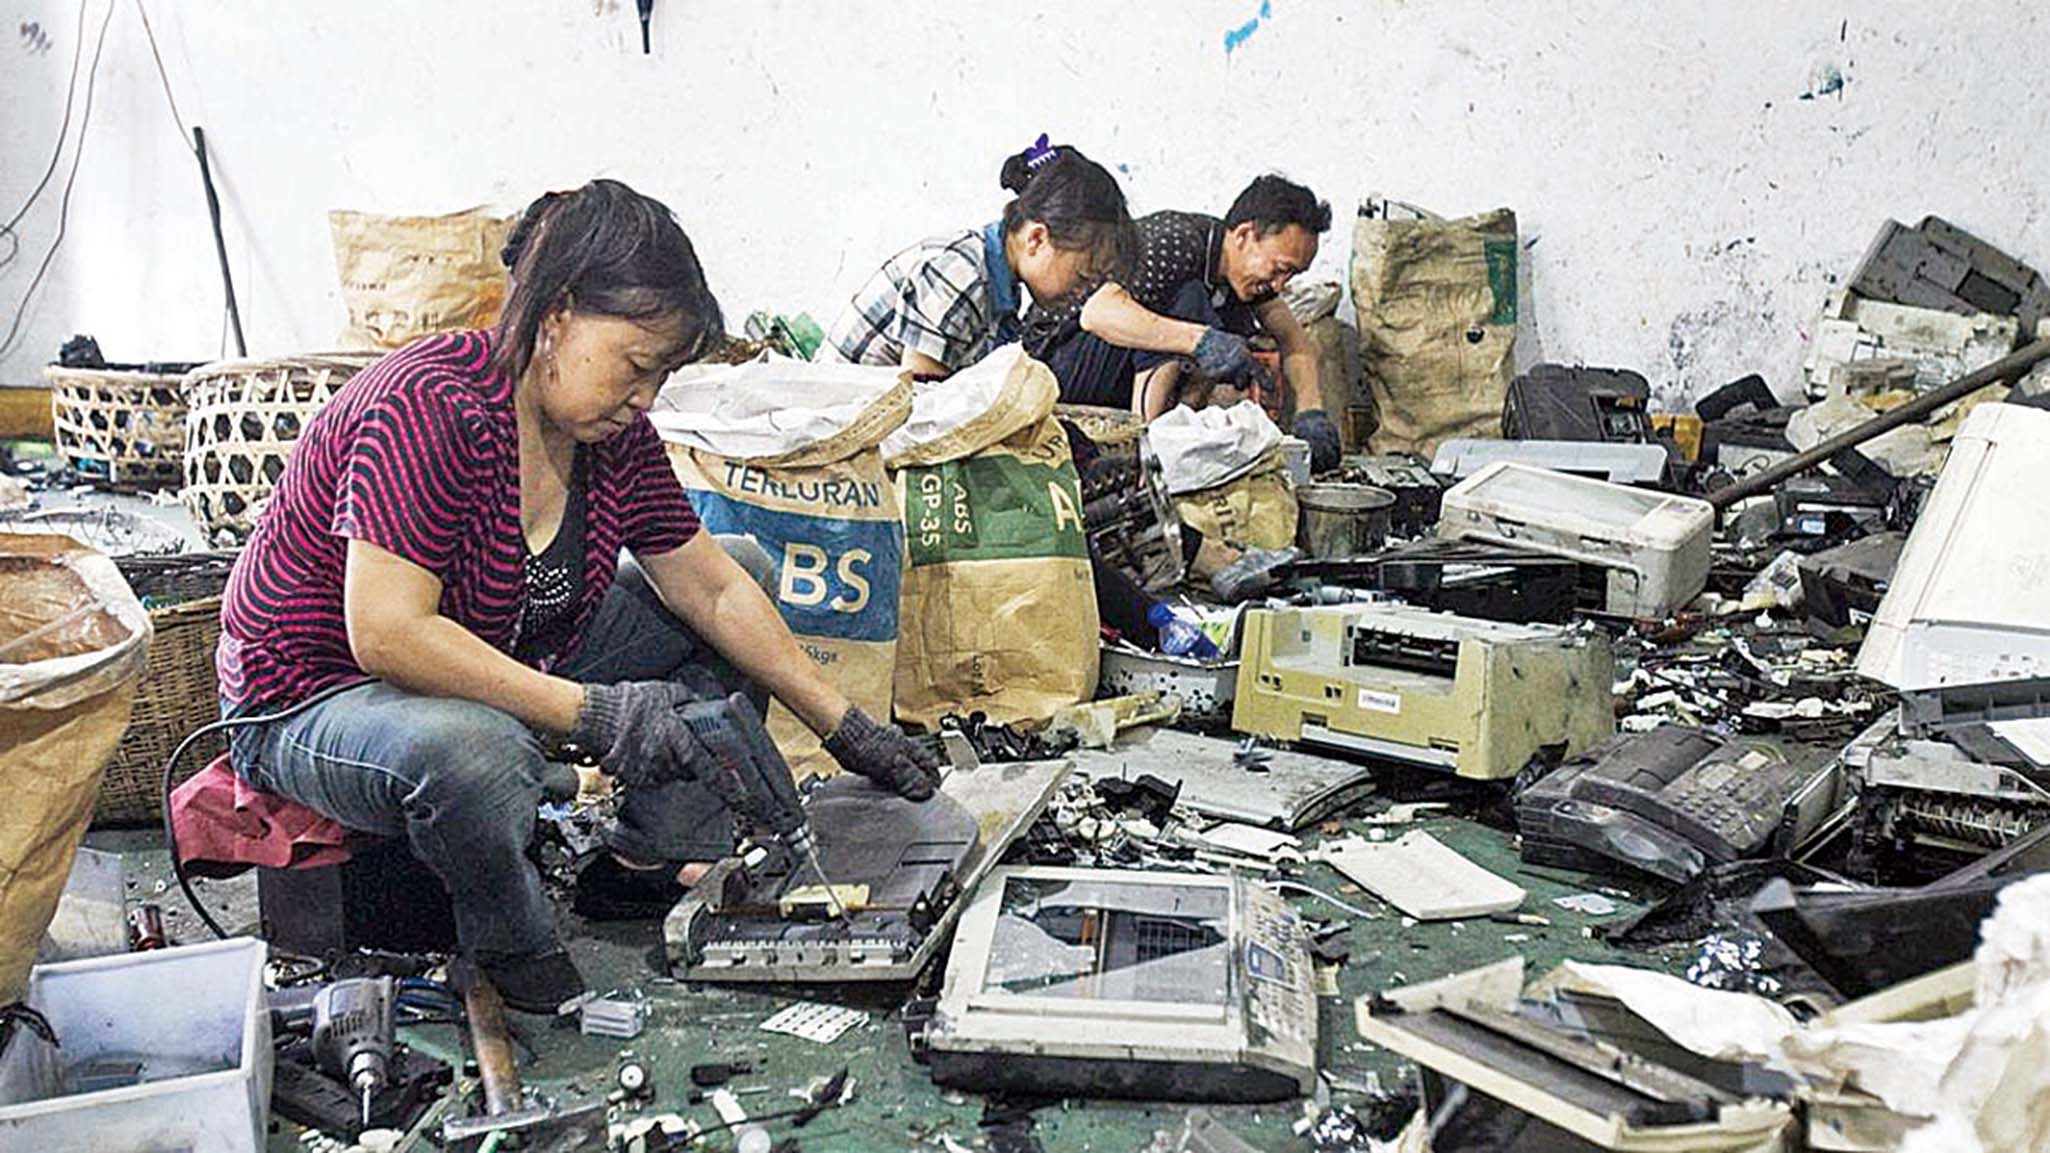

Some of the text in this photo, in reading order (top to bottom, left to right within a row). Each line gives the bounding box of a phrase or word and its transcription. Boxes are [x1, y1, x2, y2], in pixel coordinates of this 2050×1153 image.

[724, 460, 880, 507] TERLURAN
[920, 473, 943, 546] GP-35
[952, 482, 972, 534] ABS
[1048, 479, 1084, 532] A
